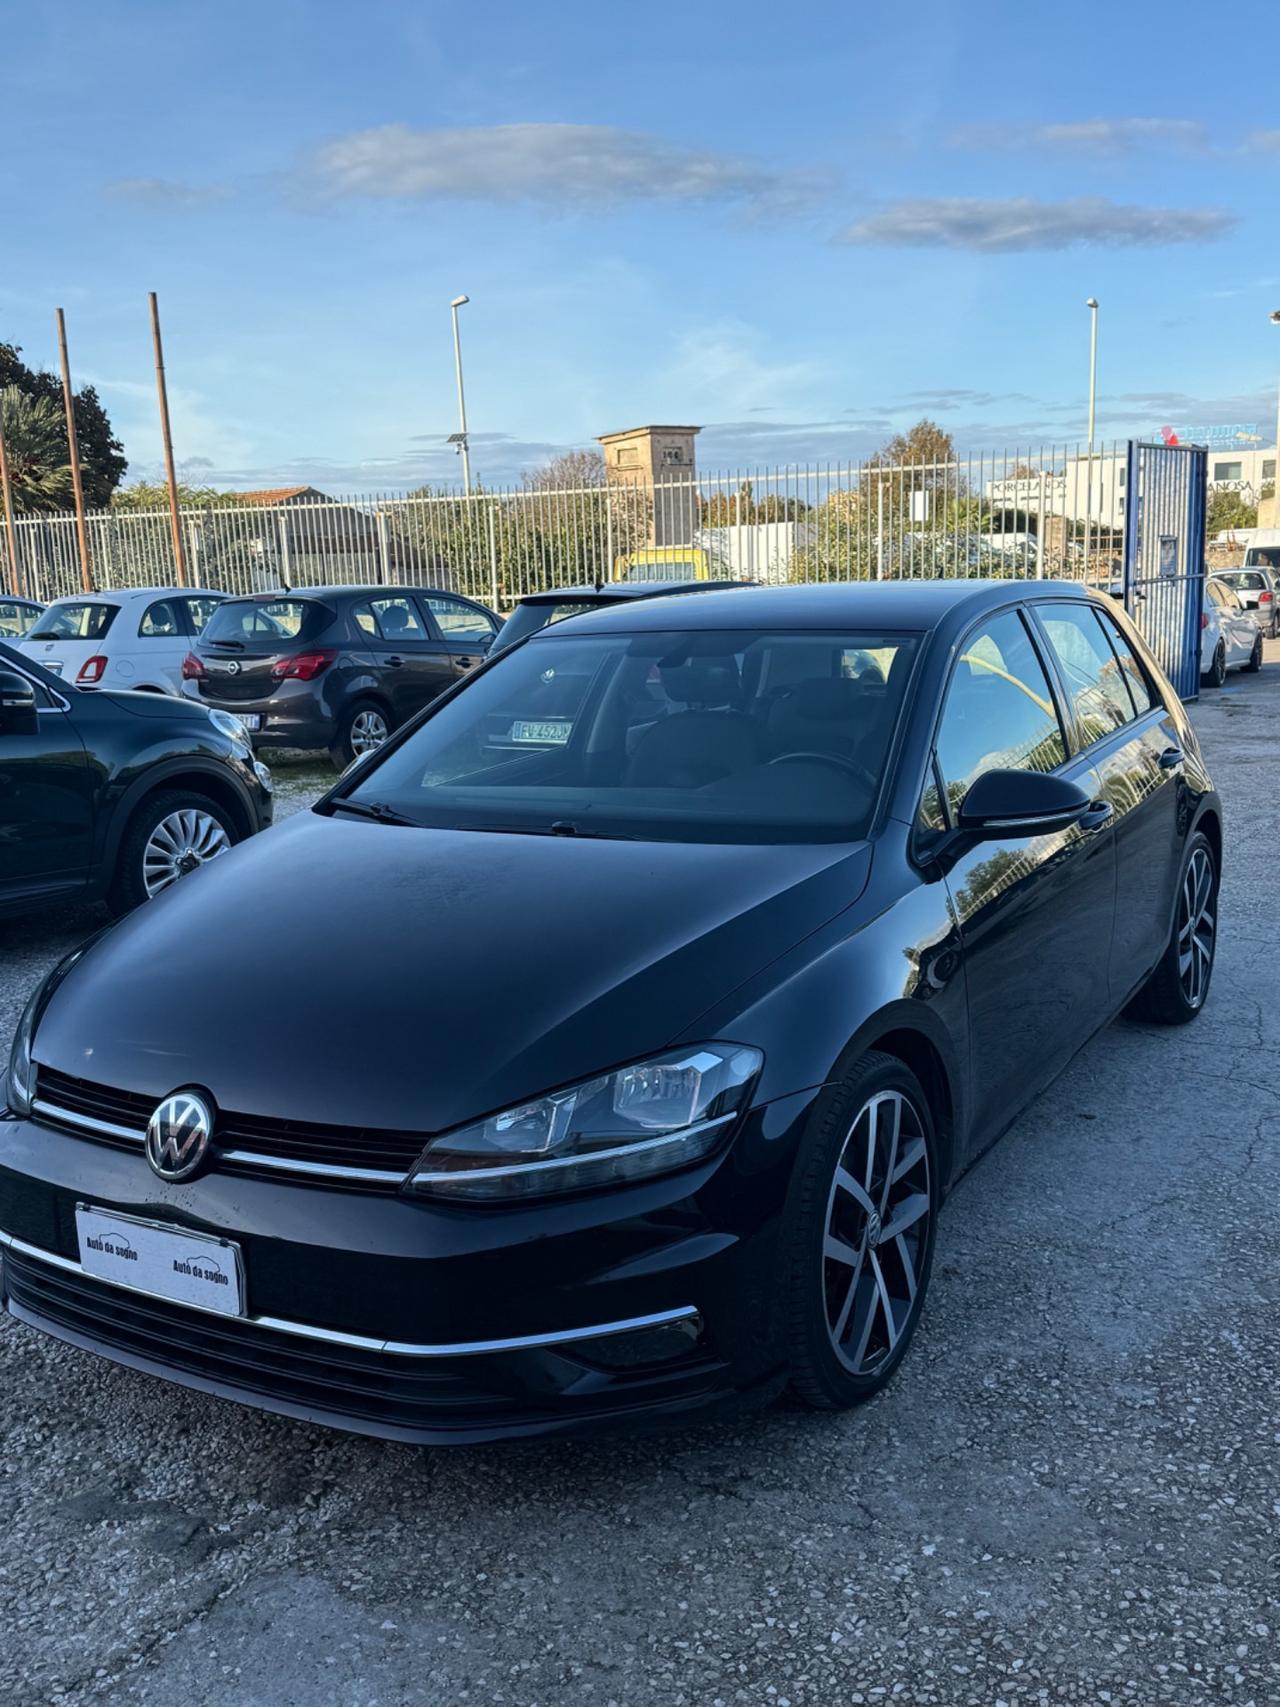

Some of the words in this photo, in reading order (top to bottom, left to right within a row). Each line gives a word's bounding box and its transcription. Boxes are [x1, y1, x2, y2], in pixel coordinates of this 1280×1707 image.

[87, 1236, 103, 1250] Auto
[104, 1242, 114, 1254] da
[115, 1246, 138, 1261] sogno
[173, 1259, 191, 1274] Auto
[193, 1265, 203, 1278] da
[204, 1271, 228, 1286] sogno
